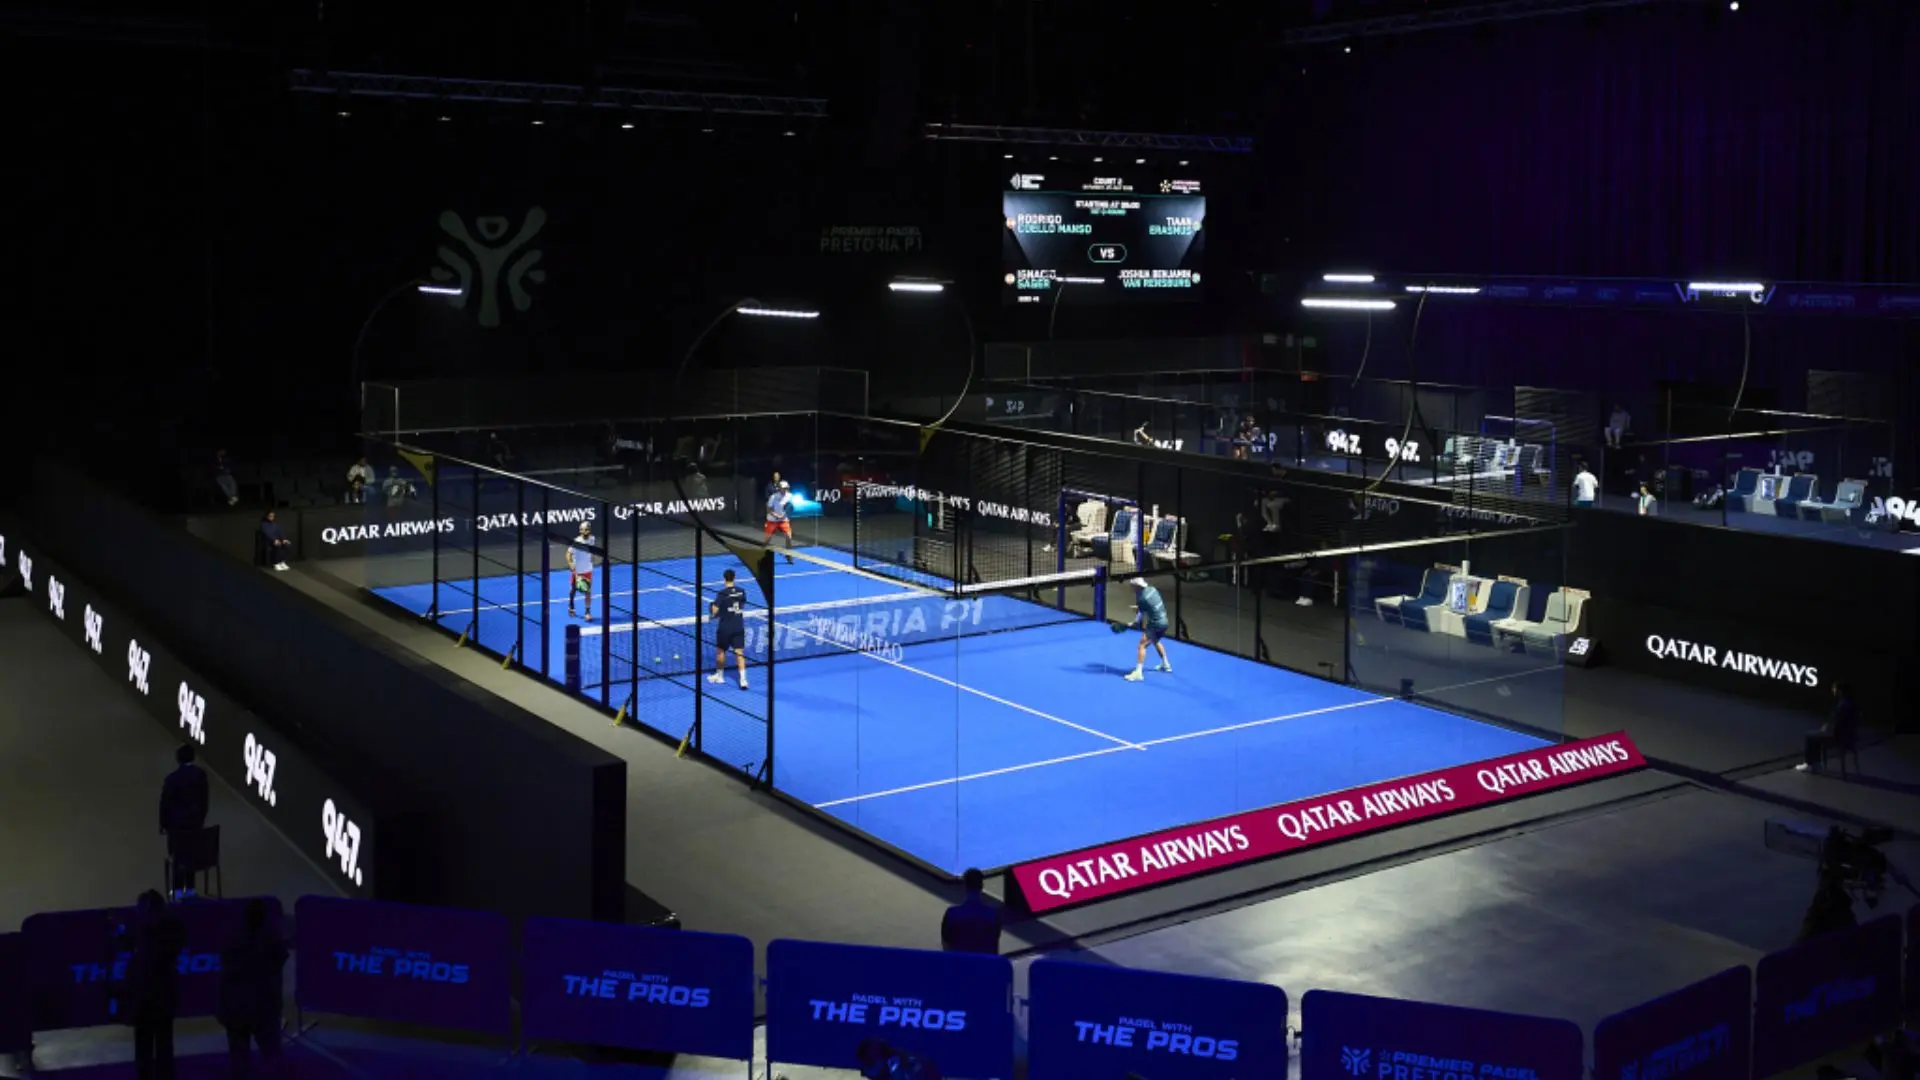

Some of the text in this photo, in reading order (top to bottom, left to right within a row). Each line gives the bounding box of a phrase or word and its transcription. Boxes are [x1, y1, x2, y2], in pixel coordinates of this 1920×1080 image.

[1018, 214, 1062, 224] RODRIGO
[1057, 224, 1092, 234] MANSO
[820, 237, 900, 252] PRETORIA
[1100, 248, 1115, 258] VS
[531, 507, 596, 526] ARWAYS
[977, 500, 1009, 519] QATAR
[322, 517, 455, 545] QATAR AIRWAYS
[1646, 634, 1819, 687] QATAR AIRWAYS
[178, 681, 205, 744] 947.
[244, 732, 276, 807] 947.
[1476, 739, 1630, 794] QATAR AIRWAYS
[1277, 778, 1456, 840] QATAR AIRWAYS
[322, 798, 362, 887] 947.
[1038, 825, 1250, 900] QATAR AIRWAYS
[333, 951, 470, 984] THE PROS
[562, 973, 711, 1009] THE PROS
[852, 992, 922, 1008] PADEL WITH
[808, 999, 967, 1032] THE PROS
[1118, 1015, 1193, 1034] PADEL WITH
[1073, 1019, 1240, 1062] THE PROS
[1392, 1050, 1475, 1073] PREMIER
